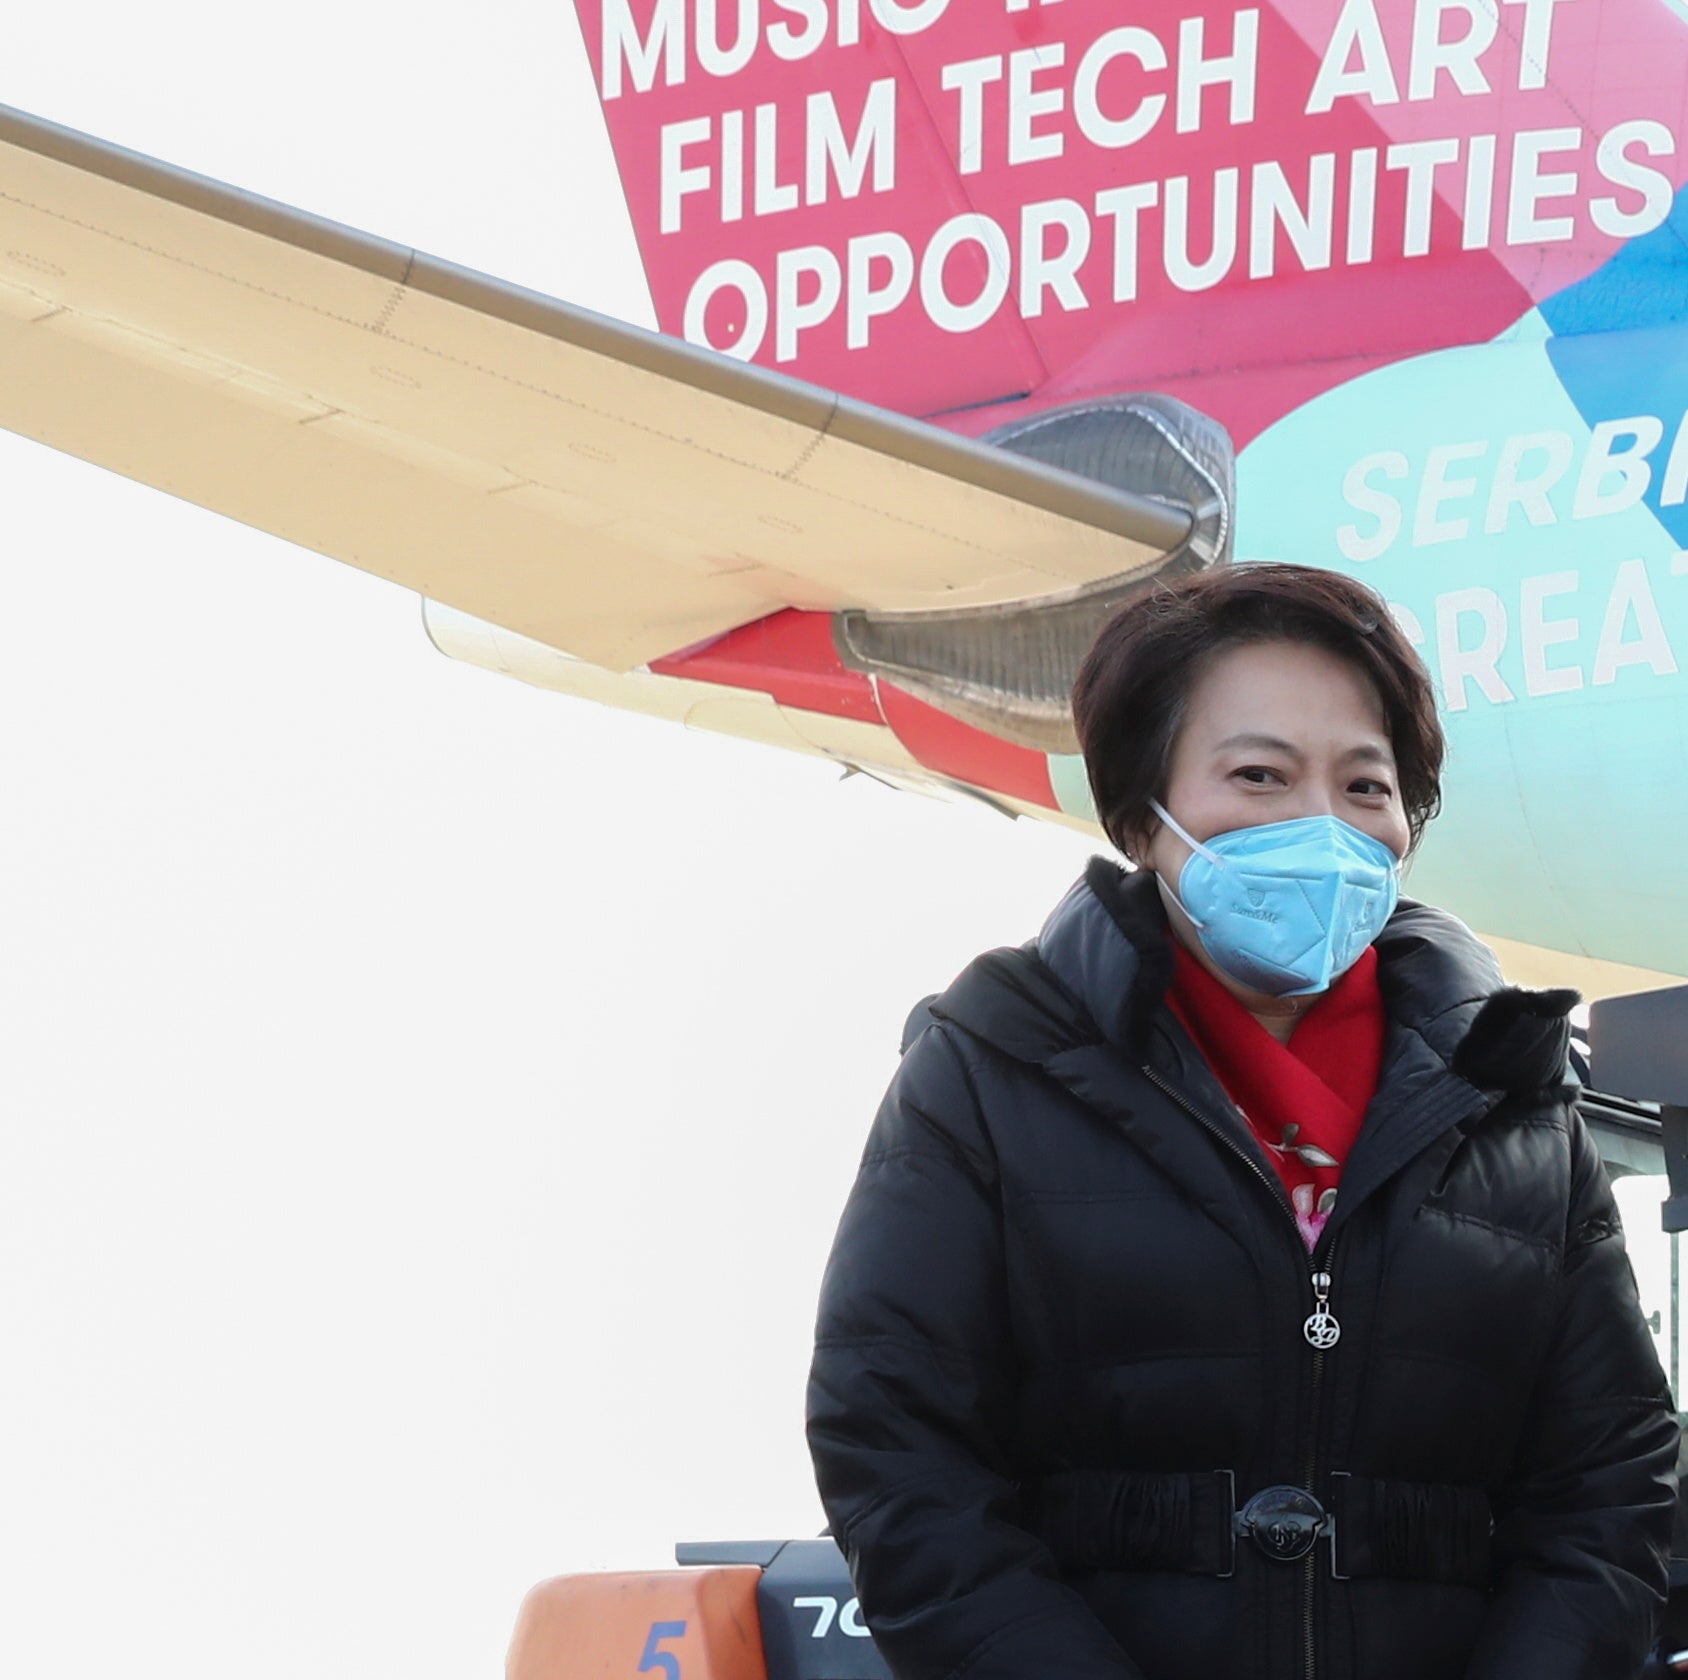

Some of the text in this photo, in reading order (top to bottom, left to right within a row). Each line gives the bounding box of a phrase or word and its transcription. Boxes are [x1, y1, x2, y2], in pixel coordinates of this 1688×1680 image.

[660, 0, 1556, 234] FILM TECH ART
[683, 119, 1676, 364] OPPORTUNITIES
